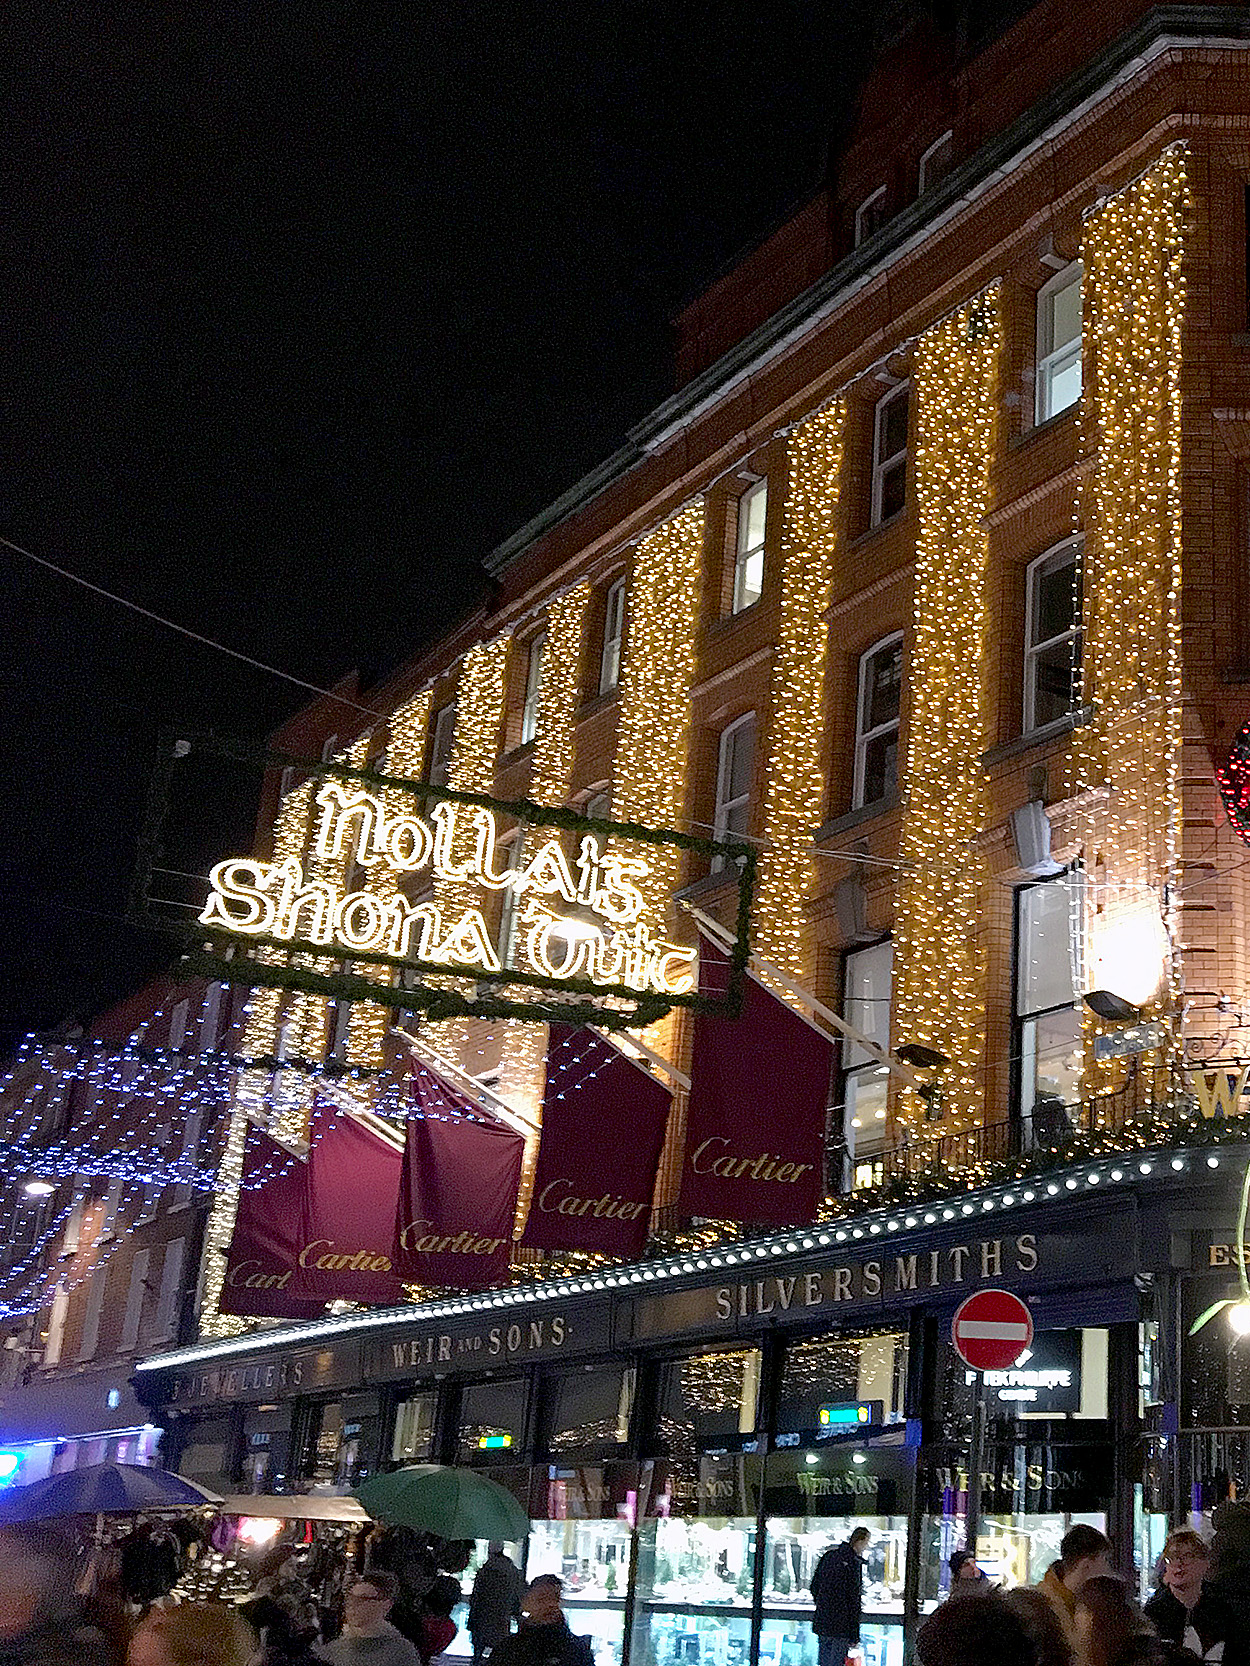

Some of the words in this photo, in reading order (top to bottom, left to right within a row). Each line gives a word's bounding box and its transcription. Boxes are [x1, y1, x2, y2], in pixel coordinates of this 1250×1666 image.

[198, 856, 501, 973] Shona
[692, 1136, 813, 1183] Cartier
[539, 1178, 648, 1220] Cartier
[299, 1240, 393, 1273] Cartie
[400, 1219, 507, 1256] Cartier
[228, 1259, 293, 1290] Cart
[715, 1233, 1040, 1321] SILVERSMITHS
[392, 1334, 452, 1369] WEIR
[488, 1316, 566, 1356] SONS
